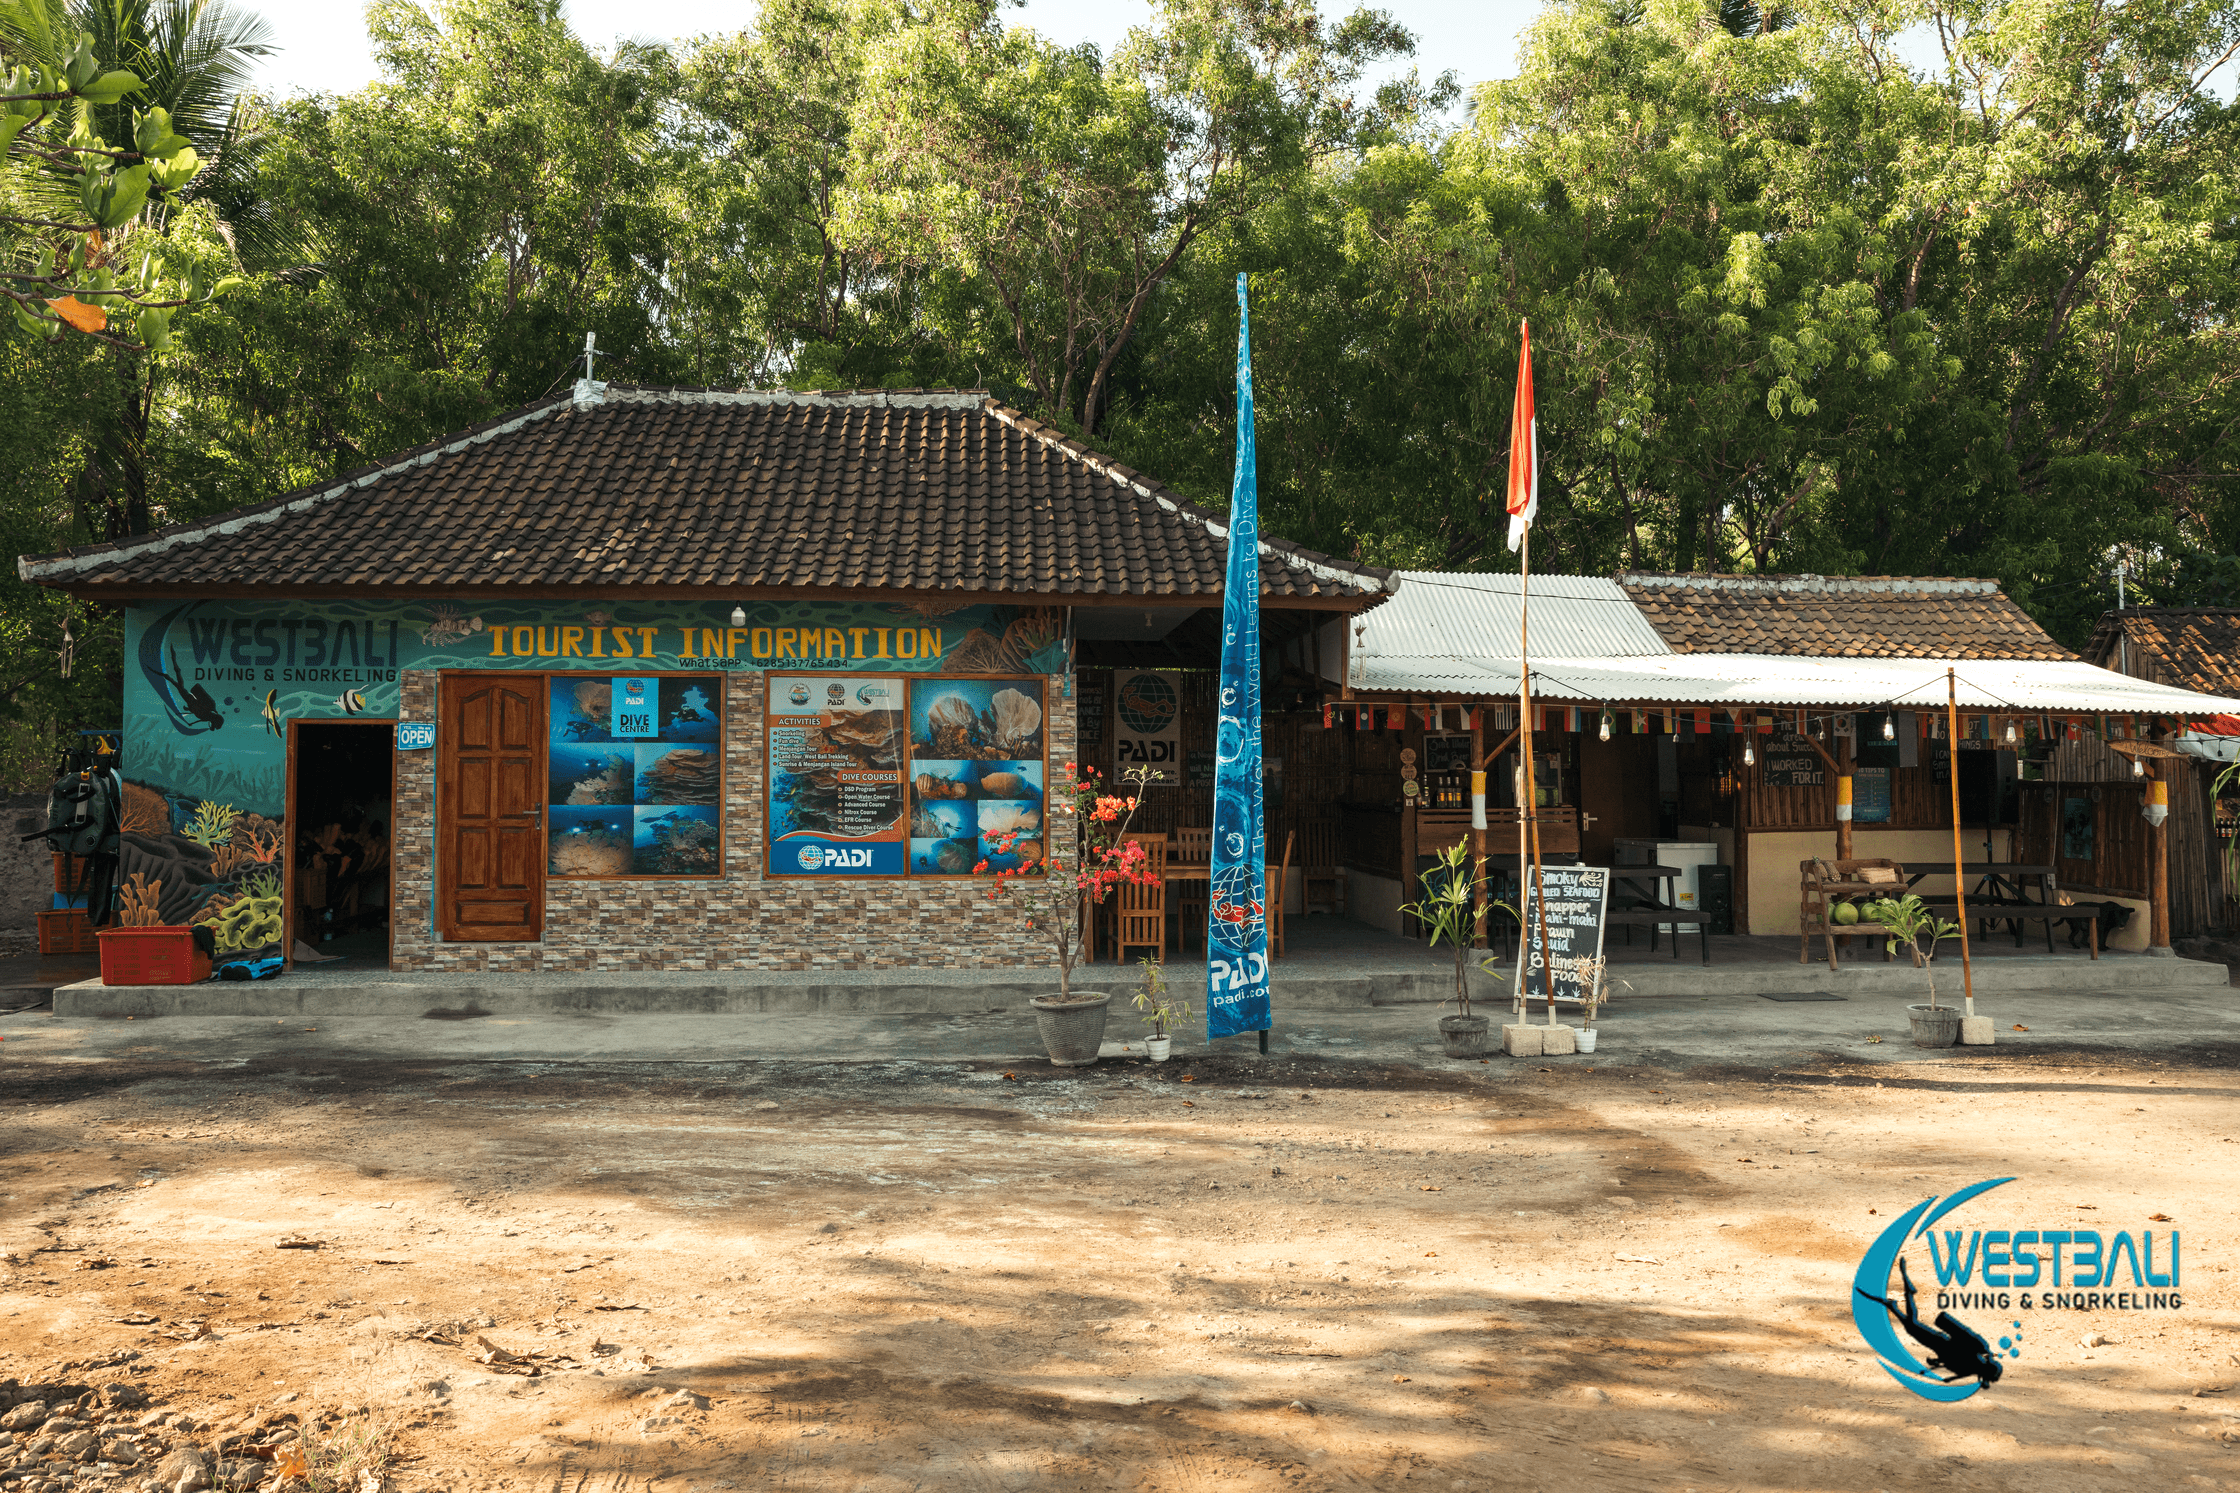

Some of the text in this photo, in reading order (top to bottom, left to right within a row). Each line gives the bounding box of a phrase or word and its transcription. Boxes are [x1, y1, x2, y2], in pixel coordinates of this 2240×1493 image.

[1237, 490, 1254, 536] Dive
[1243, 543, 1256, 562] to
[1245, 569, 1258, 634] Learns
[187, 617, 398, 667] WESTBALI
[487, 626, 942, 659] TOURIST INFORMATION
[195, 667, 397, 682] DIVING & SNORKELING
[626, 697, 645, 705] PADI
[620, 714, 650, 726] DIVE
[779, 718, 822, 726] ACTIVITIES
[401, 729, 433, 745] OPEN
[620, 725, 650, 733] CENTRE
[1119, 740, 1175, 762] PADI
[1765, 741, 1815, 753] about Succ
[1957, 740, 1982, 750] HINGS
[828, 753, 849, 761] Trekking
[1771, 758, 1814, 772] WORKED
[1791, 771, 1825, 786] FOR IT.
[1252, 814, 1265, 853] The
[825, 849, 872, 867] PADI
[1540, 871, 1579, 889] Smoky
[1563, 886, 1600, 898] SEAFOOD
[1532, 936, 1571, 952] Suid
[1211, 947, 1270, 992] PADI
